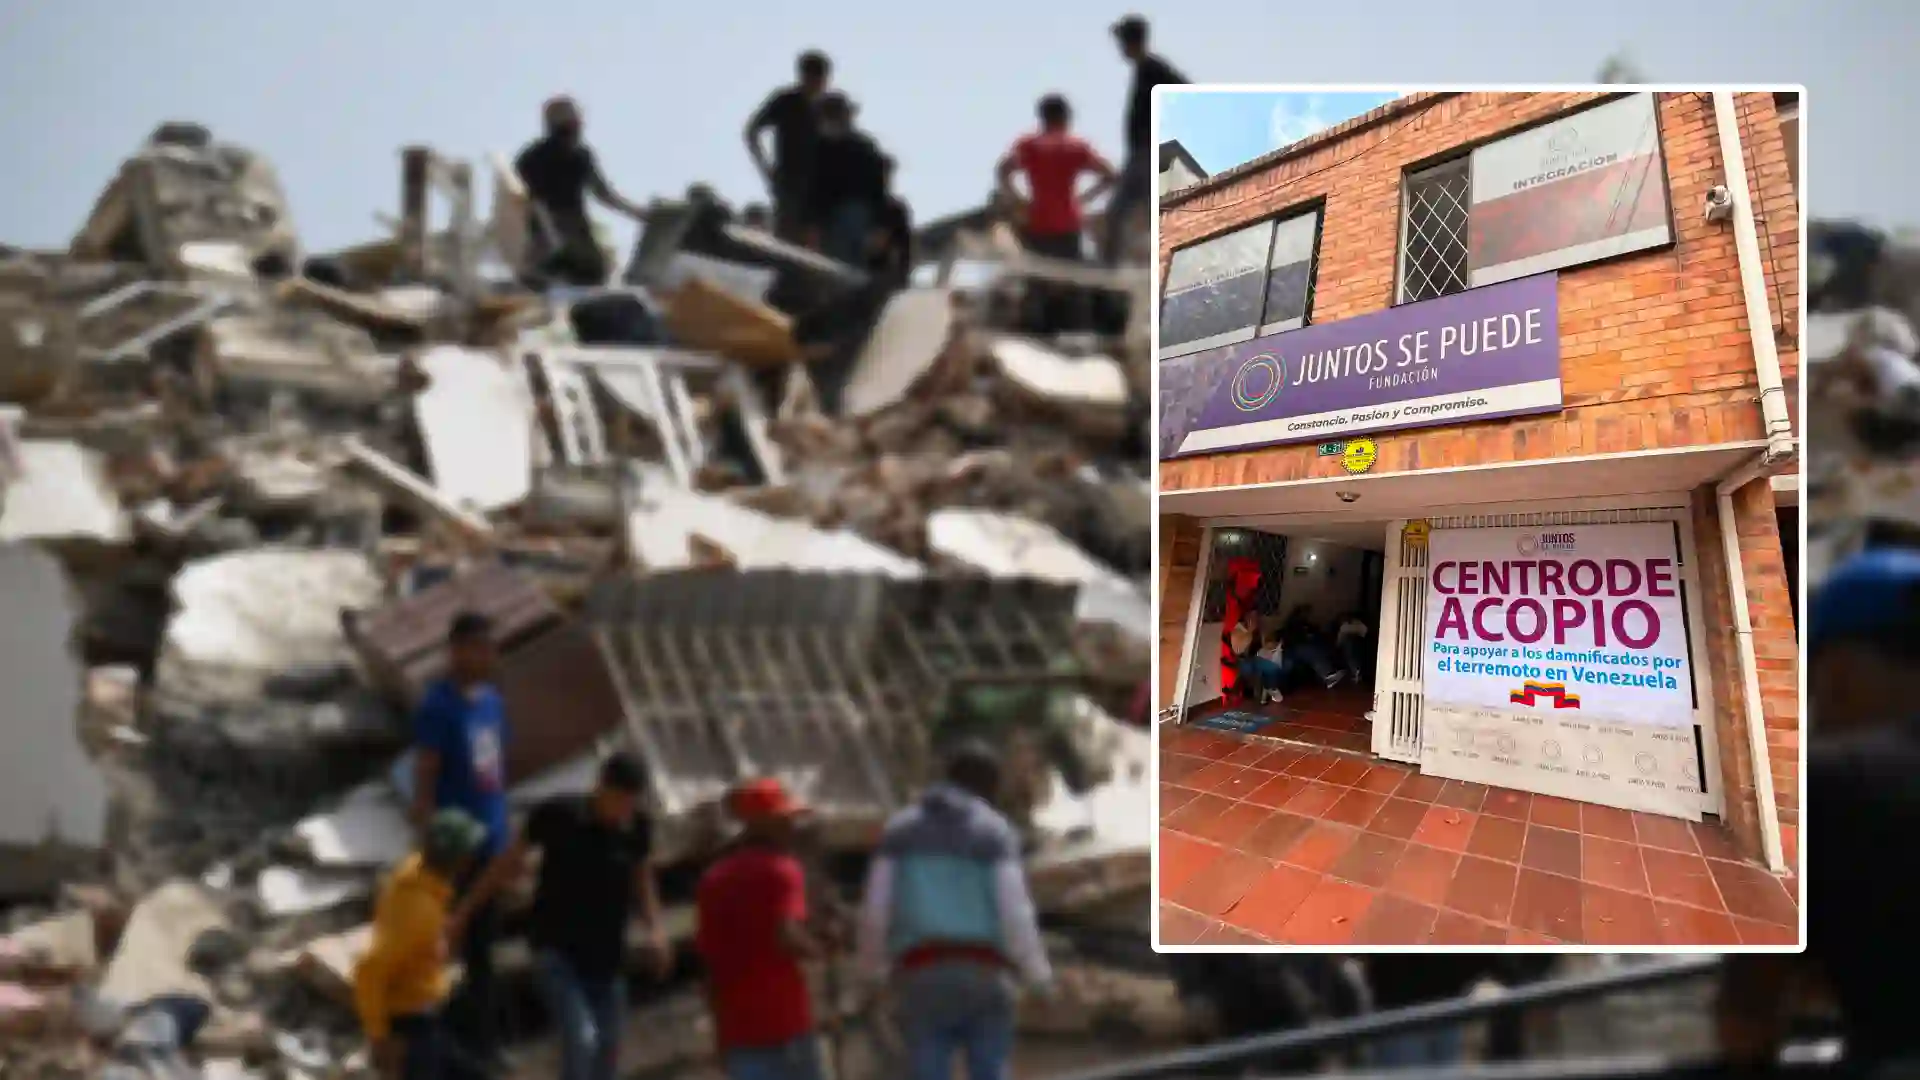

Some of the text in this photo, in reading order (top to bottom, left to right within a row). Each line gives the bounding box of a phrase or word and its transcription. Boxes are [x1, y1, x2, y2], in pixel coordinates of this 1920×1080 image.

[1293, 308, 1542, 386] JUNTOS SE PUEDE
[1369, 366, 1438, 390] FUNDACIÓN
[1351, 409, 1390, 424] Pasión
[1392, 408, 1400, 419] y
[1540, 532, 1575, 544] JUNTOS
[1435, 597, 1661, 649] ACOPIO
[1433, 641, 1682, 670] Para apoyar a los damnificados por
[1438, 657, 1677, 690] el terremoto en Venezuela
